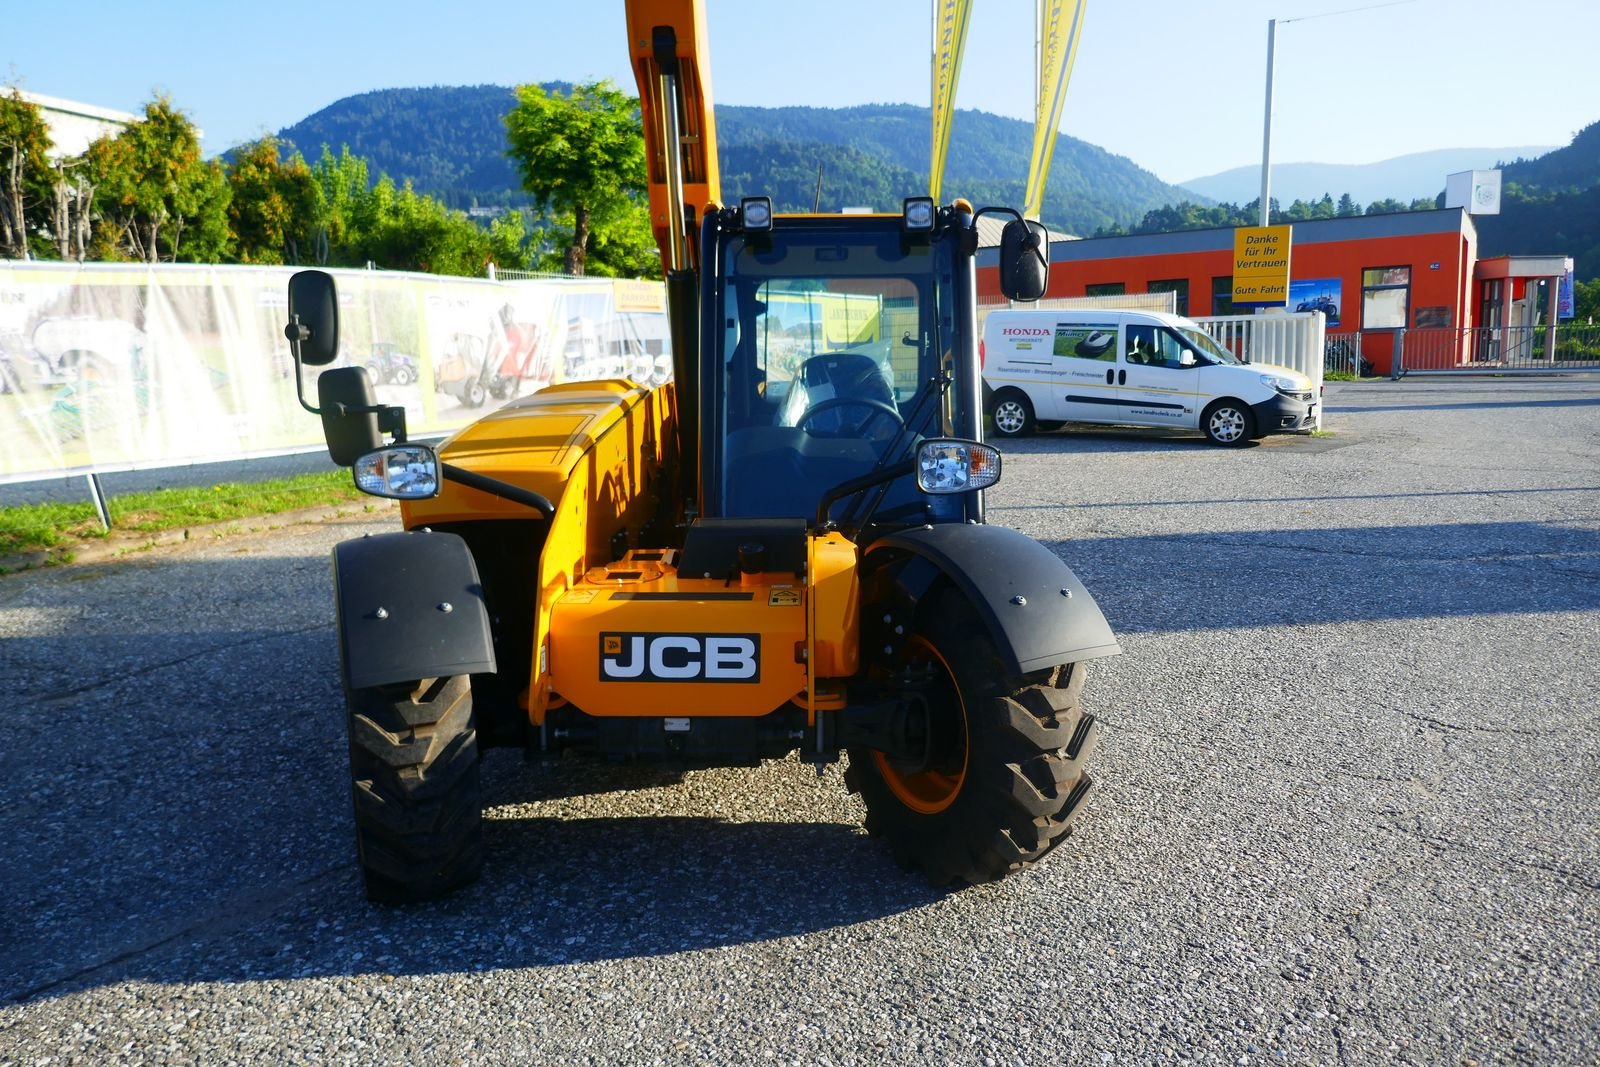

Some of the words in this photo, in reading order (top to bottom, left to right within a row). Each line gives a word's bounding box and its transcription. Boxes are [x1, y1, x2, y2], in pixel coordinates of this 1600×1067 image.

[1246, 234, 1279, 244] Danke
[1245, 247, 1260, 257] für
[1263, 247, 1277, 256] Ihr
[1236, 259, 1286, 269] Vertrauen
[1235, 286, 1257, 295] Gute
[1260, 285, 1285, 294] Fahrt
[1002, 328, 1051, 336] HONDA
[603, 636, 757, 679] JCB
